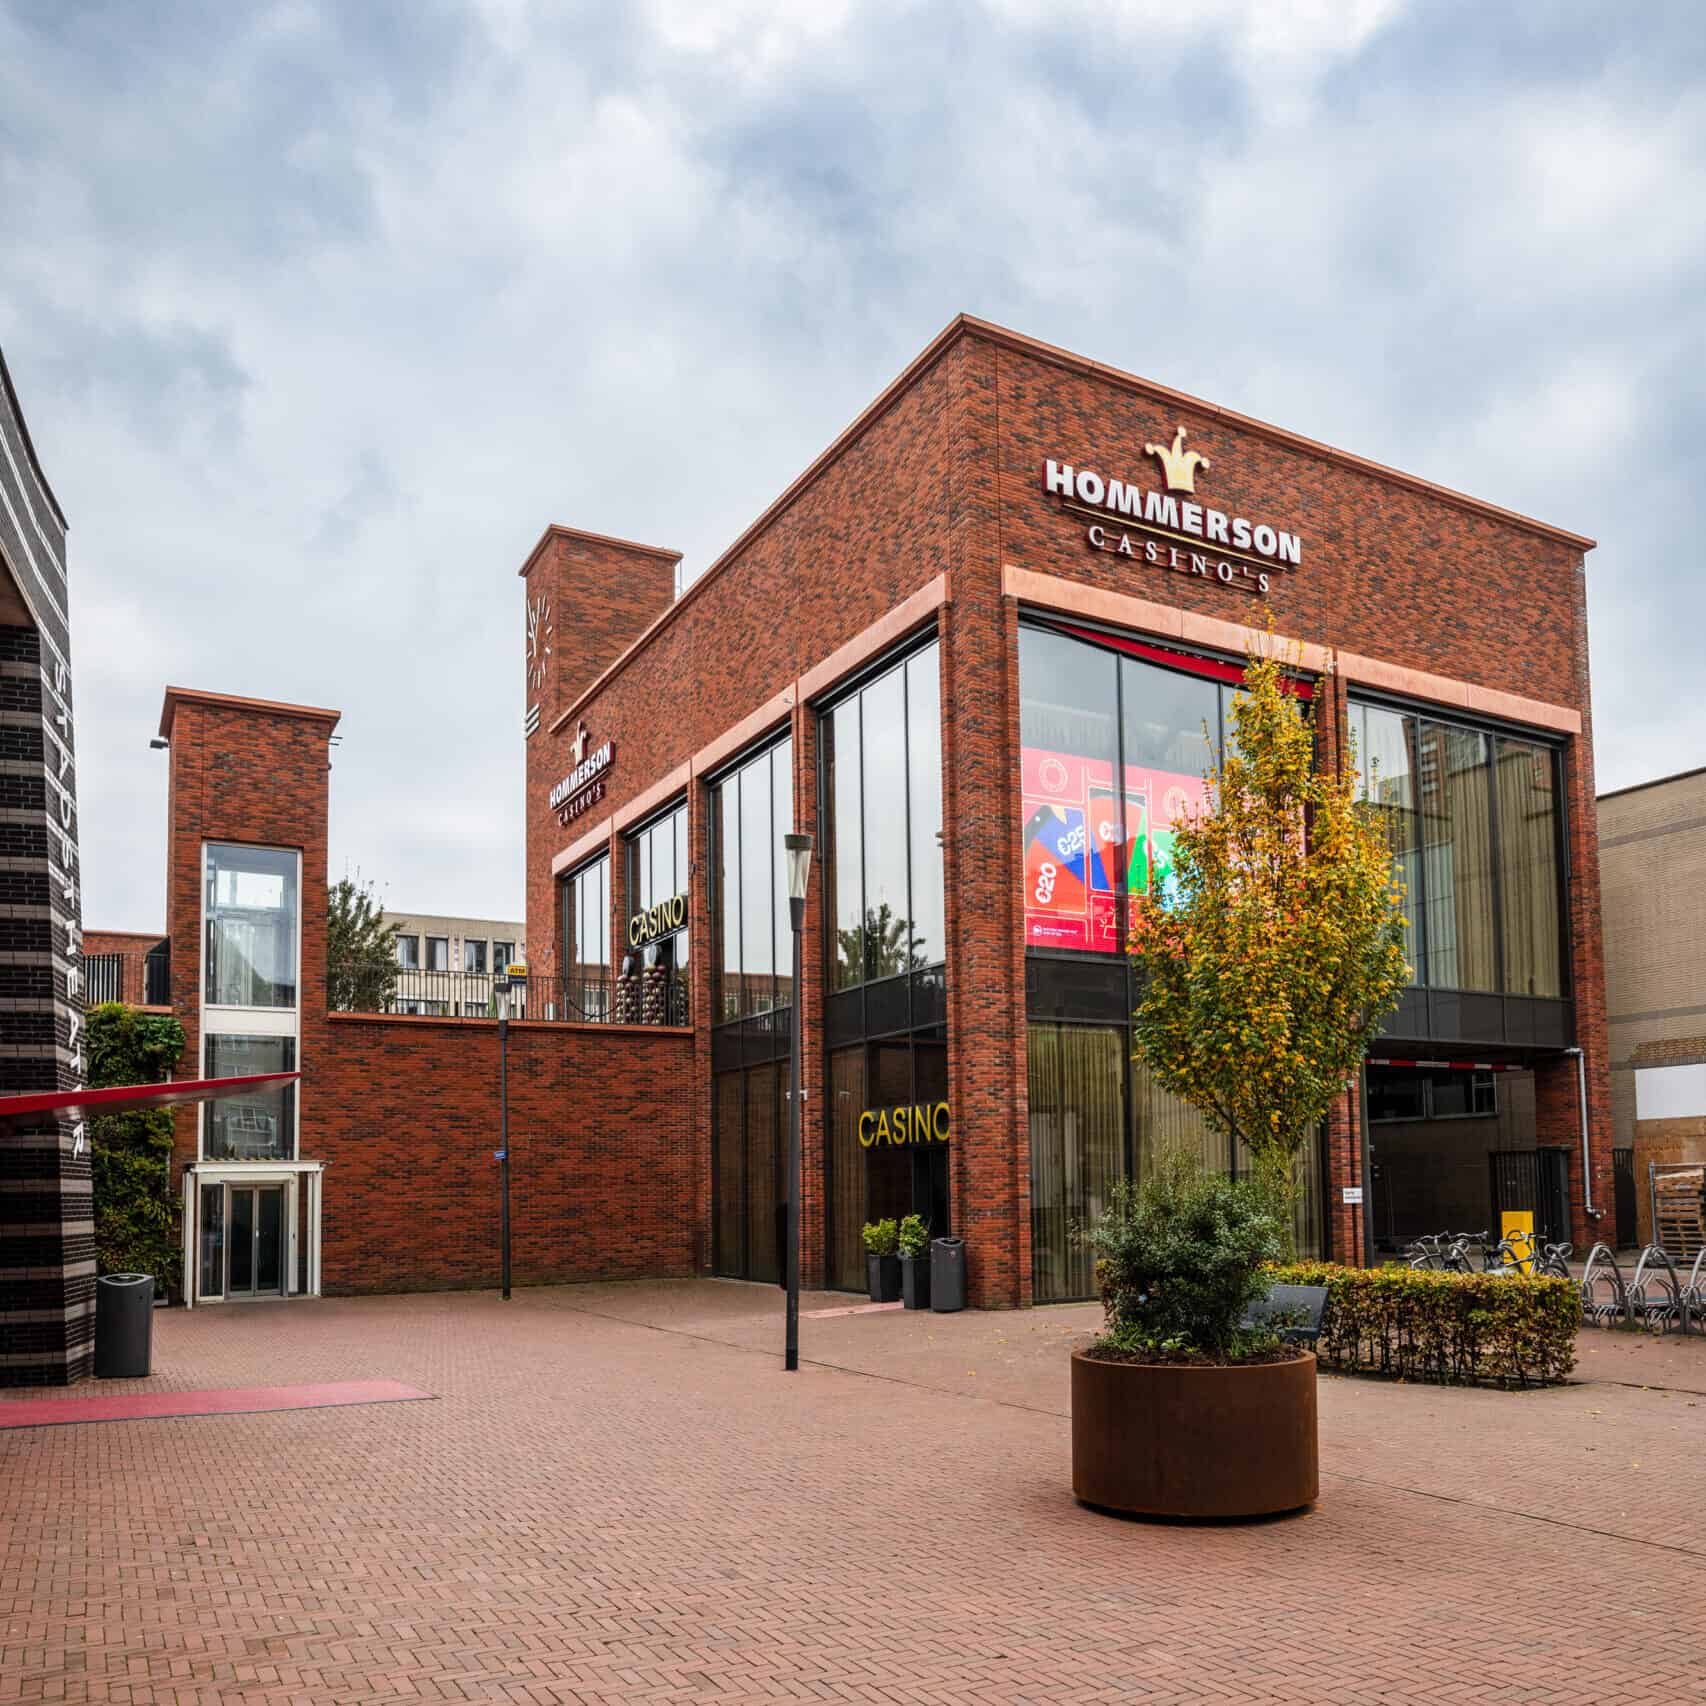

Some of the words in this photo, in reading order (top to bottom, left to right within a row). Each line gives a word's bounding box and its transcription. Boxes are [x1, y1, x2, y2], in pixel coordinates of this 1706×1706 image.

[1045, 459, 1301, 565] HOMMERSON
[1088, 525, 1270, 594] CASINO'S
[549, 741, 611, 809] HOMMERSON
[558, 782, 602, 827] CASINO'S
[54, 661, 84, 1161] STADSTHEATR
[1035, 862, 1057, 904] €20
[629, 895, 684, 946] CASINO
[858, 1102, 952, 1147] CASINO
